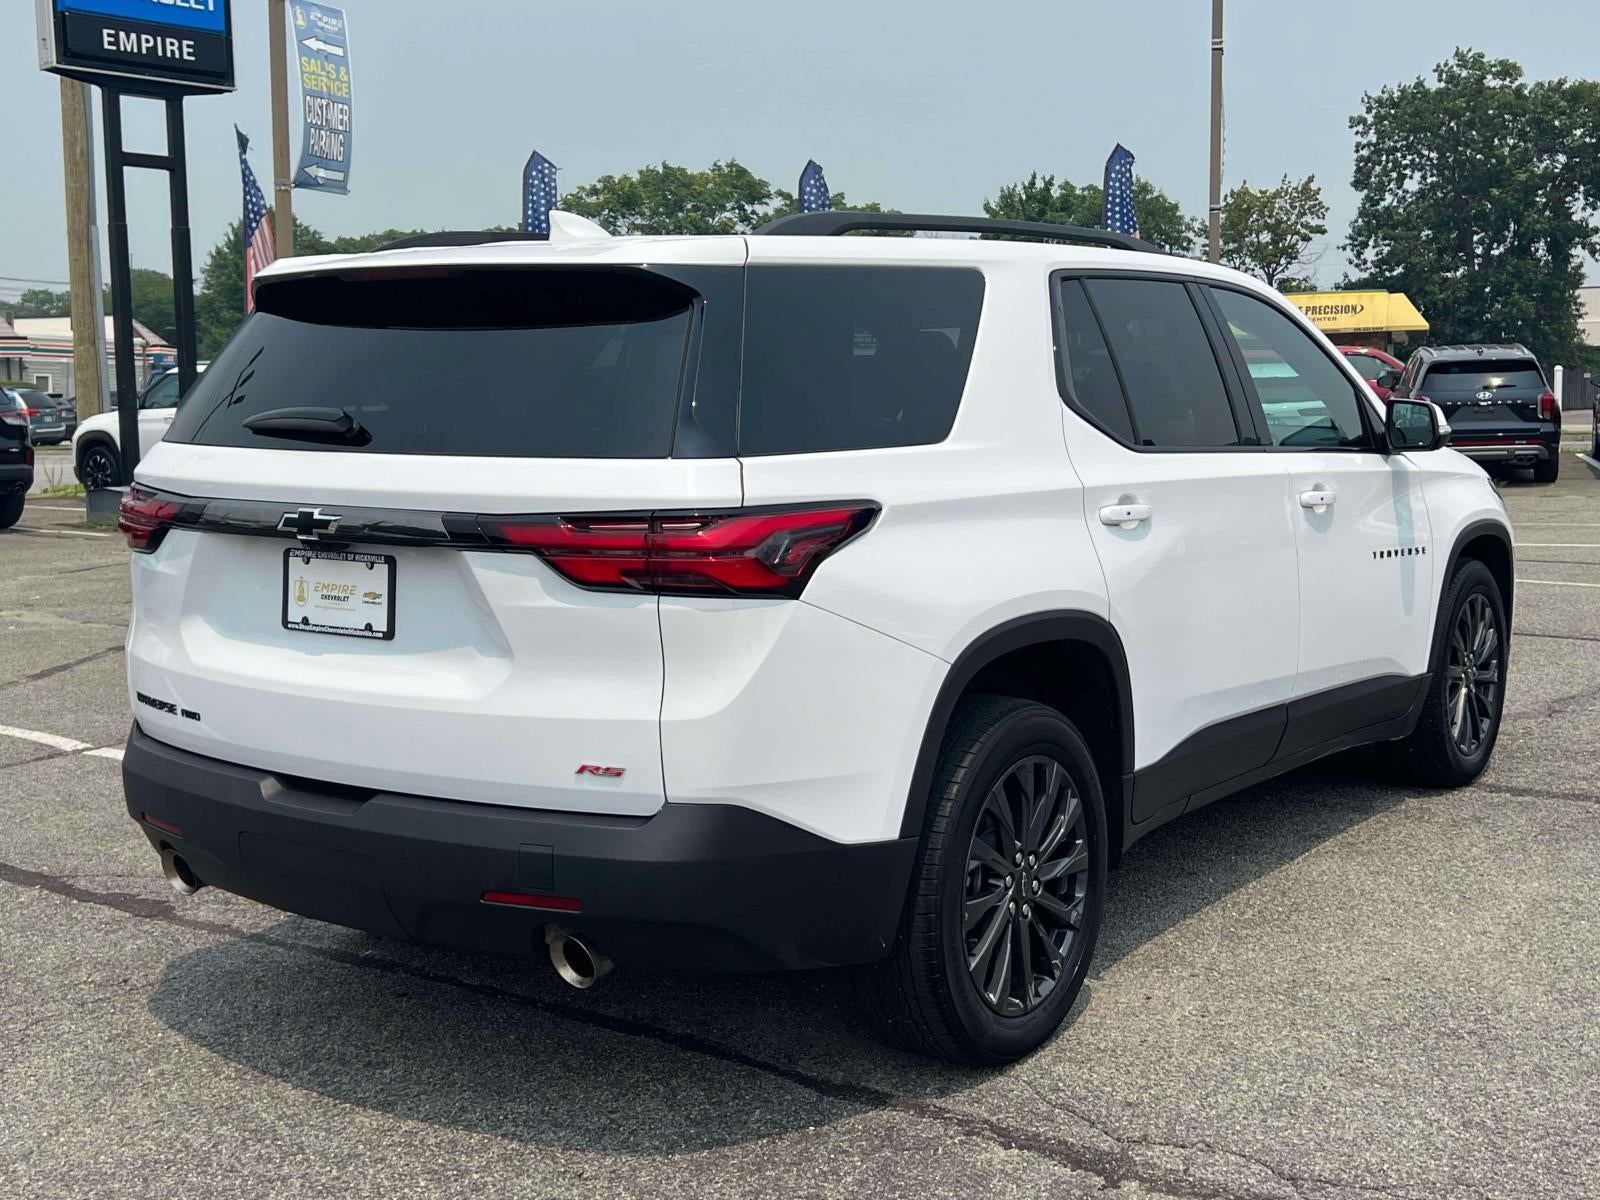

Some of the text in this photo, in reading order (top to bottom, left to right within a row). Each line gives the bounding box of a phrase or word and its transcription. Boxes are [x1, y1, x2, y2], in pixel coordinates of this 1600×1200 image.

[102, 28, 196, 61] EMPIRE
[340, 66, 348, 81] &
[1305, 304, 1357, 315] PRECISION
[289, 550, 317, 558] EMPIRE
[1372, 546, 1427, 560] TRAVERSE
[314, 582, 357, 595] EMPIRE
[320, 594, 350, 602] CHEVROLET
[575, 764, 626, 777] RS
